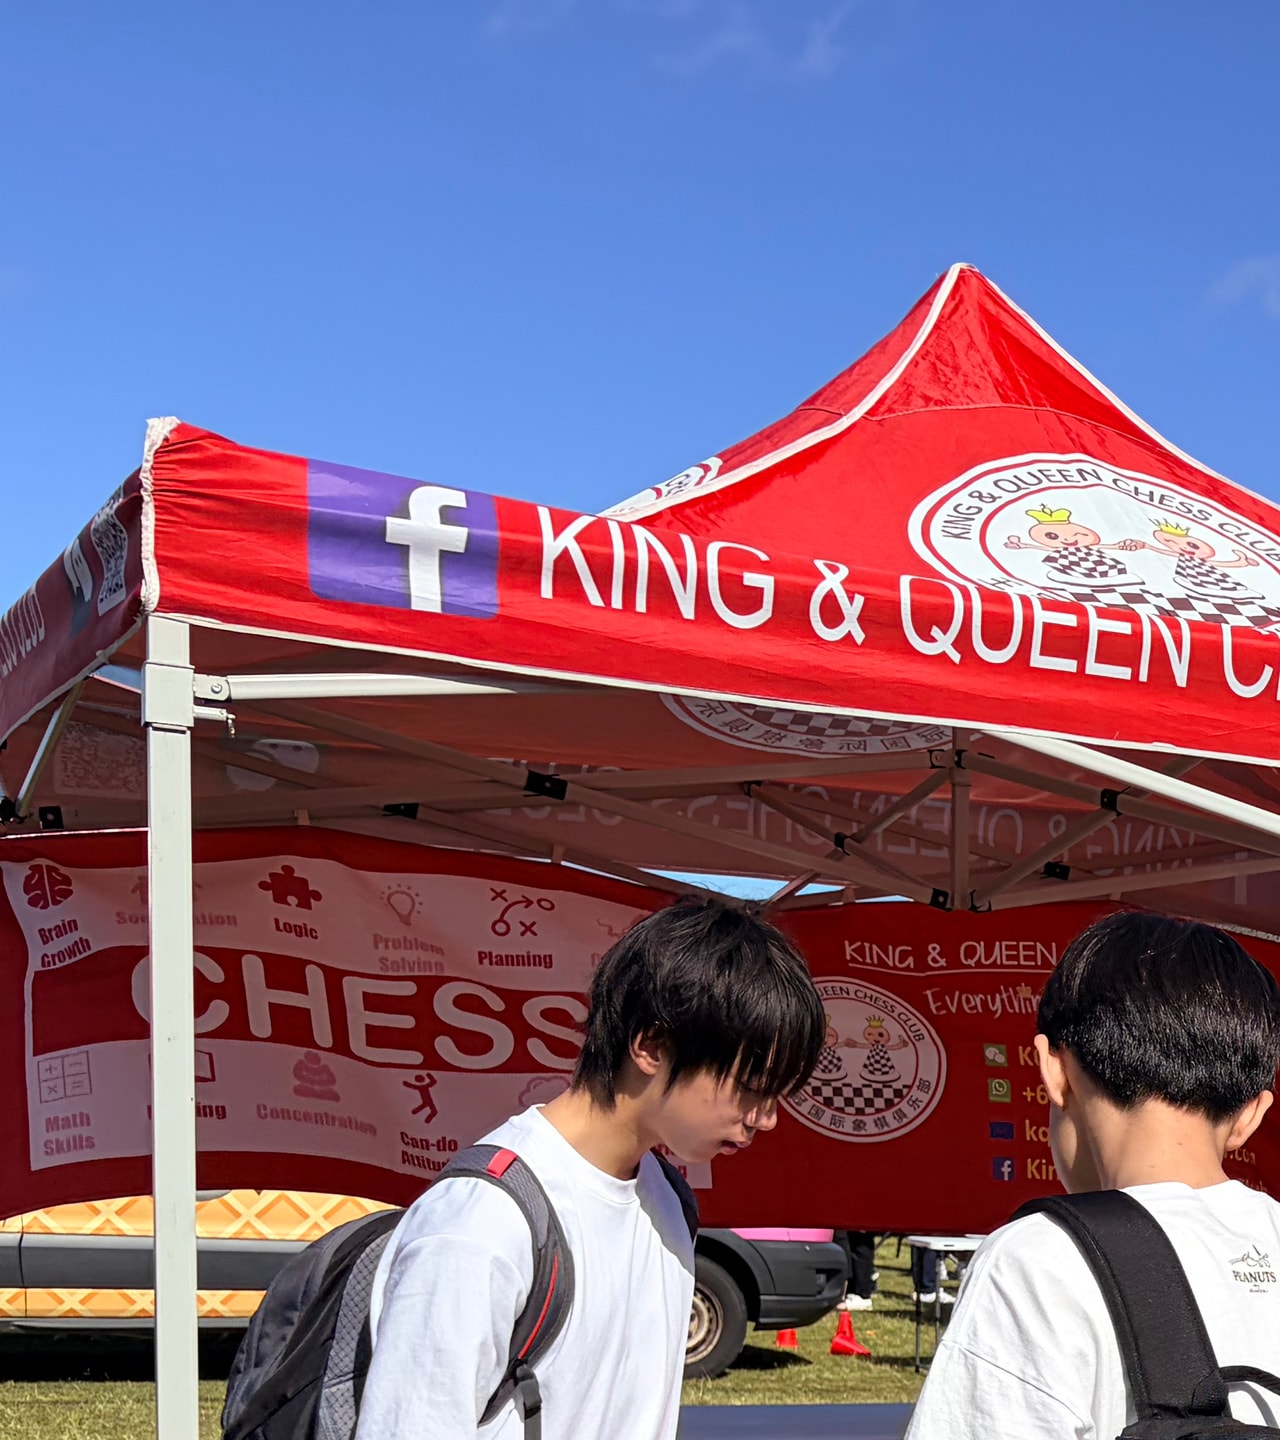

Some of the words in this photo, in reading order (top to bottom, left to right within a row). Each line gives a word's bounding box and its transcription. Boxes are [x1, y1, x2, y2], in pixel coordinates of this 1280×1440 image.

[940, 496, 979, 542] KING
[980, 484, 1003, 505] &
[1002, 466, 1104, 493] QUEEN
[1112, 476, 1214, 524] CHESS
[538, 506, 775, 630] KING
[810, 558, 866, 646] &
[899, 575, 1191, 688] QUEEN
[38, 918, 79, 946] Brain
[273, 917, 319, 940] Logic
[41, 937, 92, 969] Growth
[373, 933, 445, 957] Problem
[478, 949, 554, 969] Planning
[845, 940, 915, 970] KING
[926, 942, 948, 968] &
[960, 941, 1058, 968] QUEEN
[379, 956, 445, 974] Solving
[131, 950, 590, 1071] CHESS
[923, 983, 1042, 1019] Everythin
[854, 988, 898, 1014] CHESS
[897, 1012, 926, 1043] CLUB
[45, 1110, 92, 1134] Math
[256, 1102, 378, 1138] Concentration
[43, 1133, 96, 1157] Skills
[400, 1130, 459, 1153] Can-do
[1232, 1270, 1277, 1284] PEANUTS
